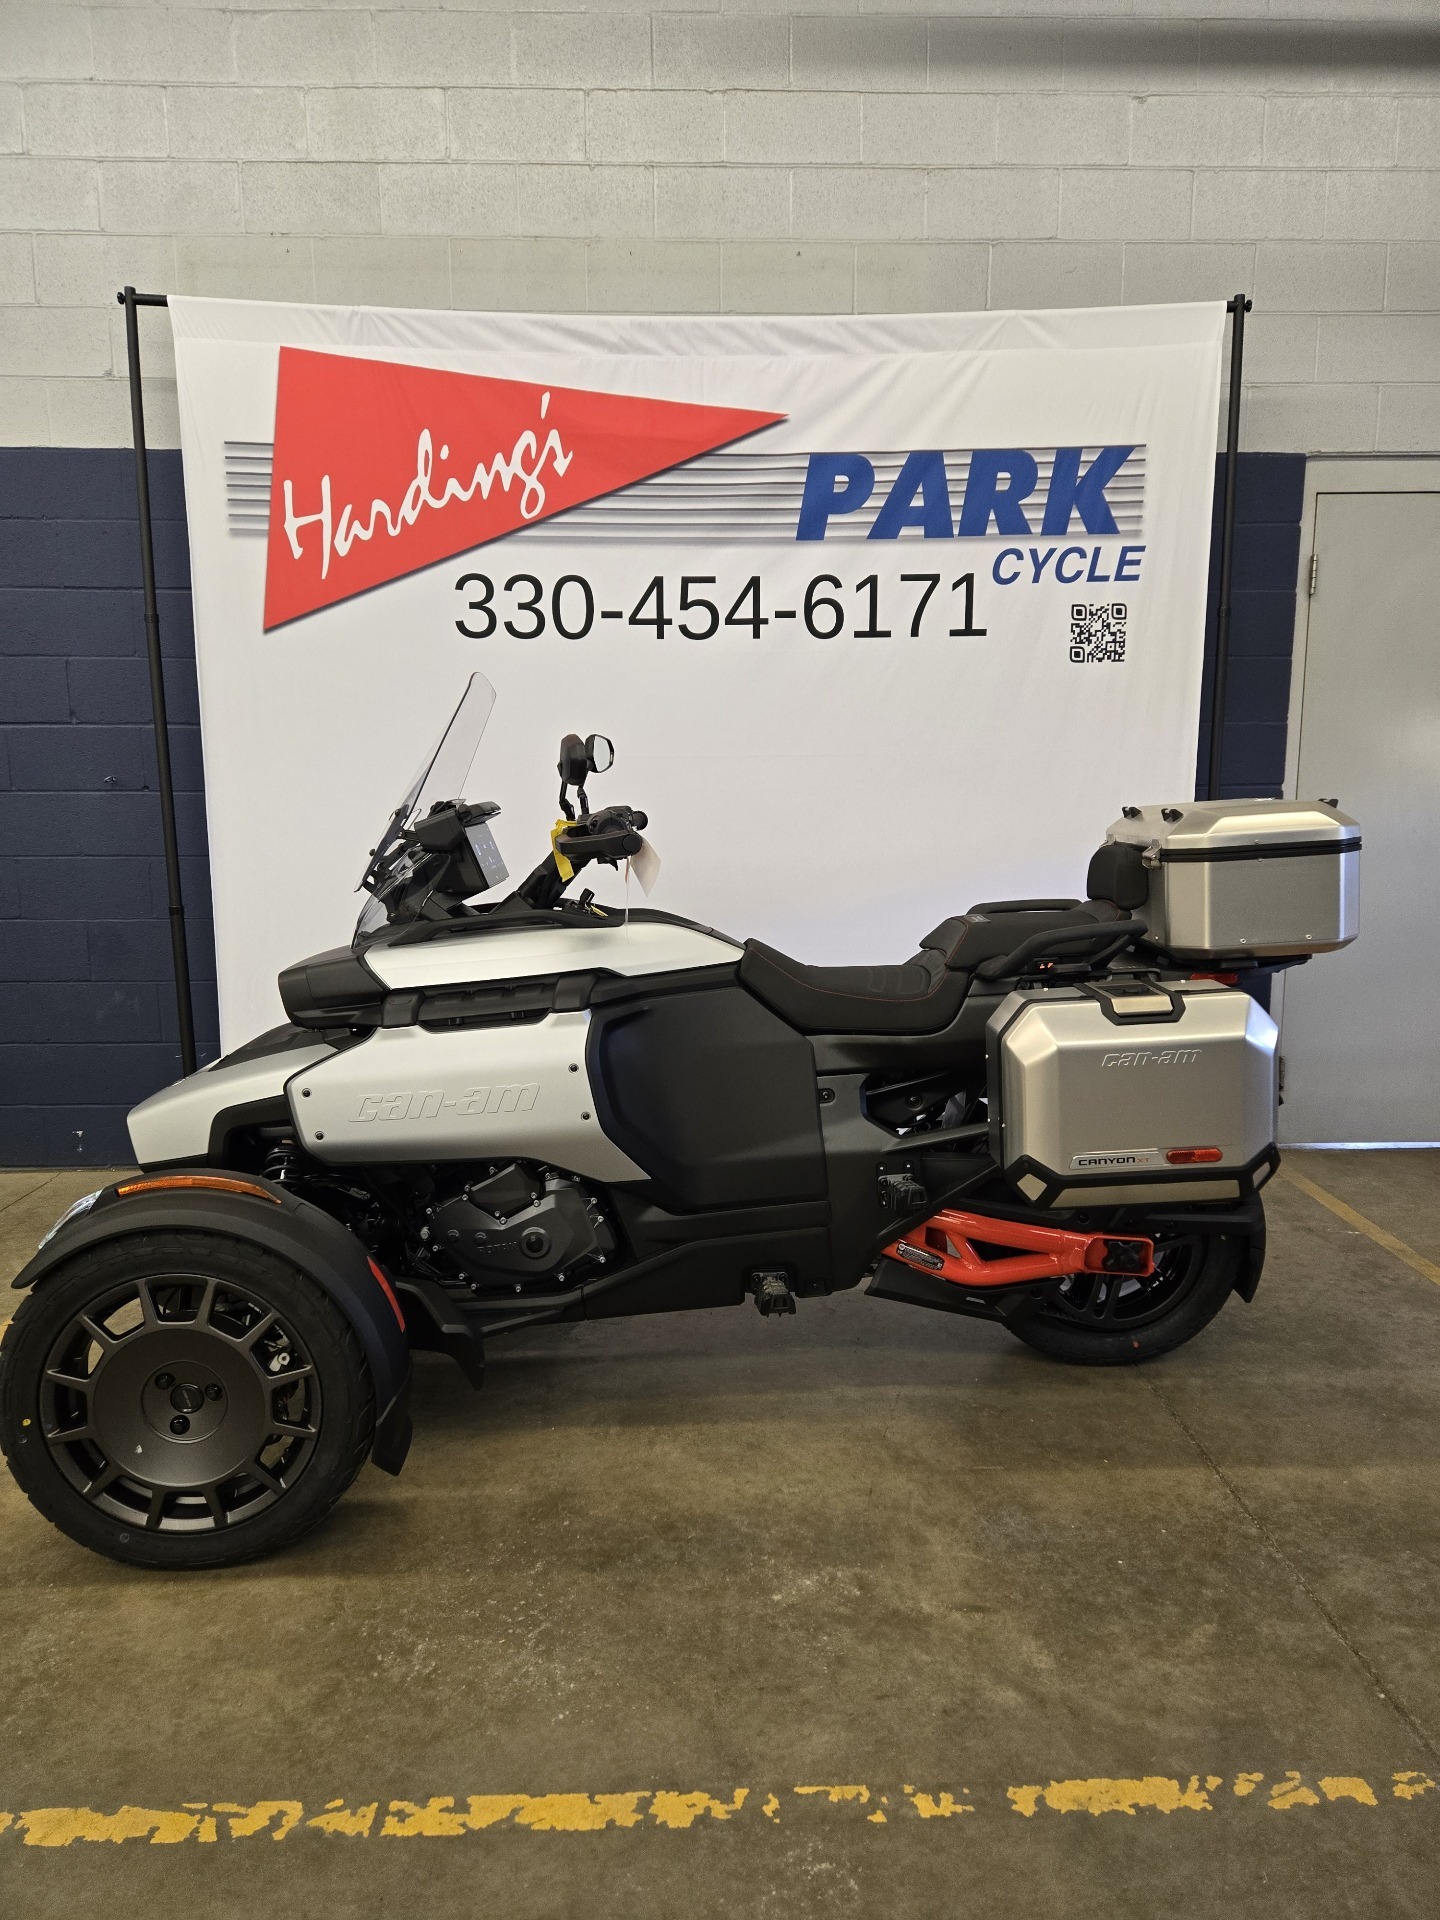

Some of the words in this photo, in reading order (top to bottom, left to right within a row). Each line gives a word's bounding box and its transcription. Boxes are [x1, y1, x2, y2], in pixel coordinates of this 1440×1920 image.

[282, 391, 573, 580] Harding's
[796, 446, 1137, 540] PARK
[992, 545, 1147, 585] CYCLE
[454, 573, 988, 641] 330-454-6171
[1101, 1048, 1203, 1067] can-am
[347, 1081, 541, 1124] can-am
[1078, 1156, 1136, 1166] CANYON
